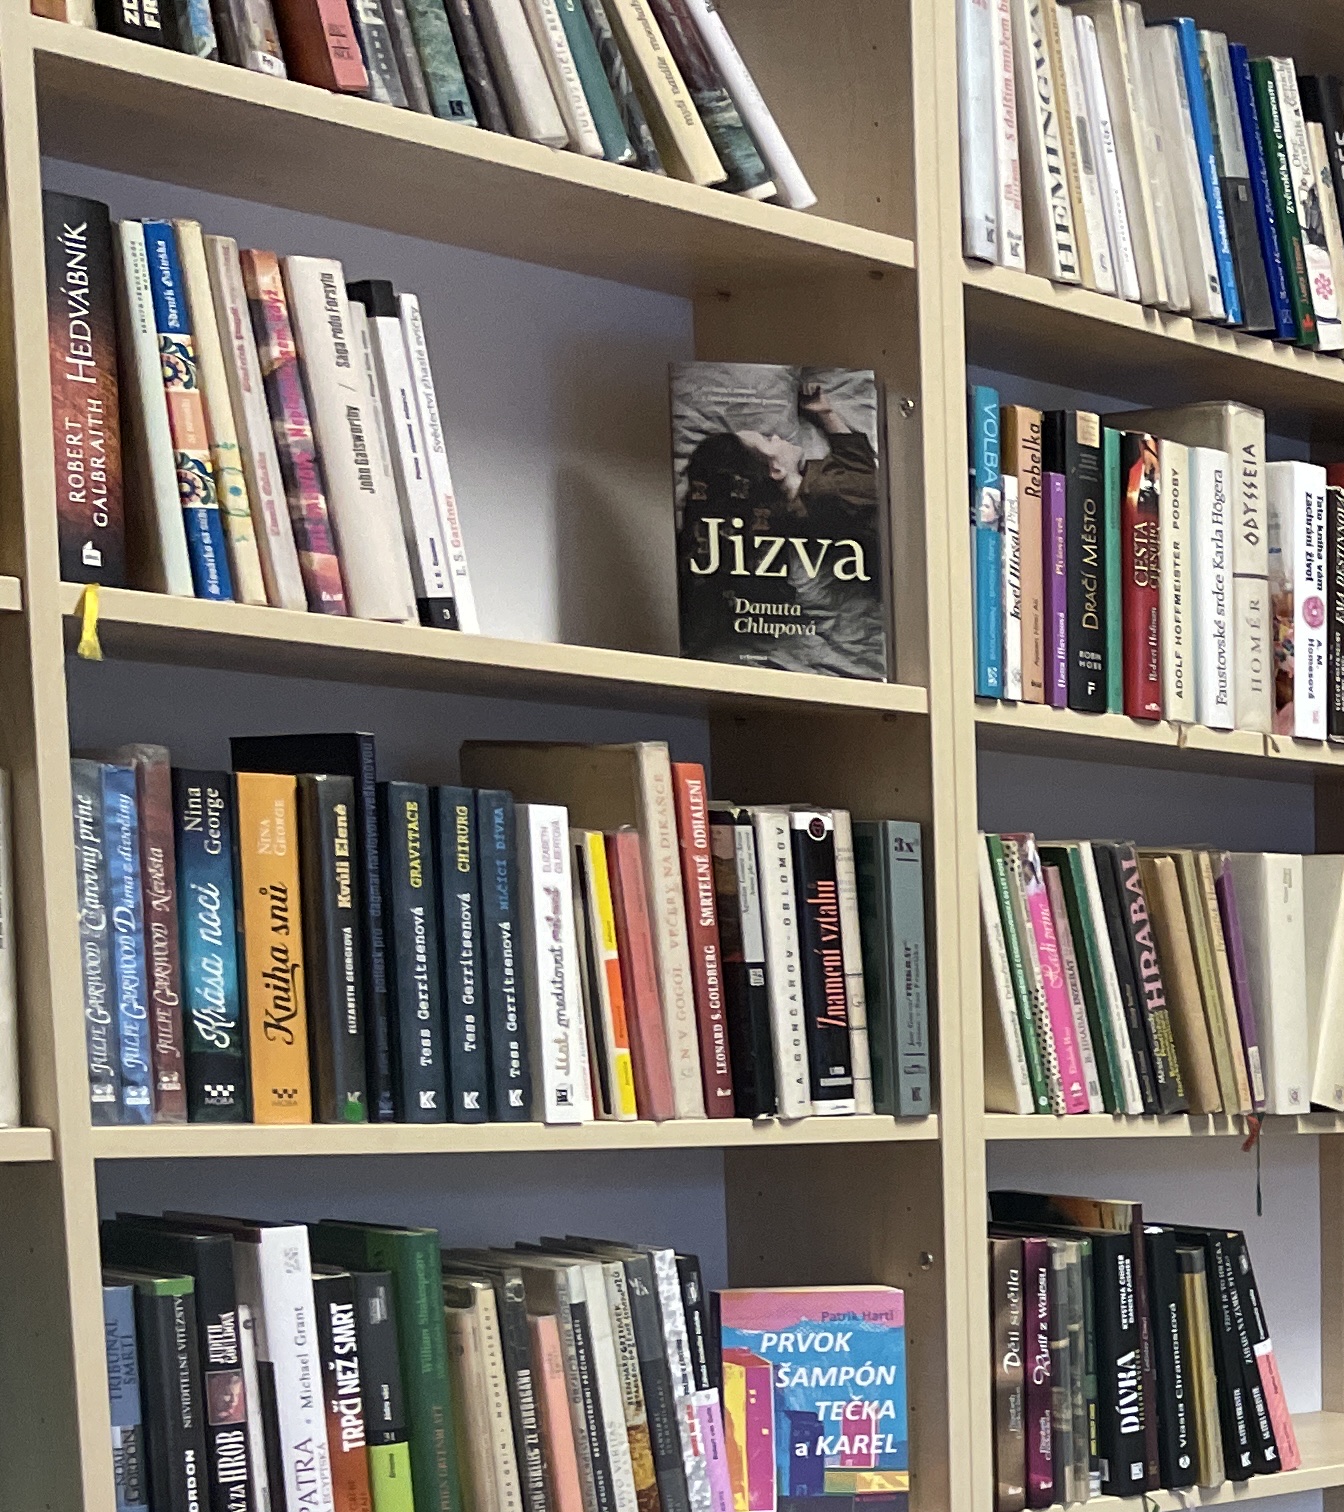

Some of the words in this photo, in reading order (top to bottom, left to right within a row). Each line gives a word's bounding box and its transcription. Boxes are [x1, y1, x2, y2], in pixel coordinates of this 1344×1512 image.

[64, 222, 96, 386] HEDVÁBNÍK
[67, 419, 86, 504] ROBERT
[90, 398, 109, 527] GALBRAITH
[983, 404, 1001, 496] VOLBA
[1024, 421, 1043, 498] Rebelka
[1173, 469, 1181, 530] PODOBY
[1212, 469, 1224, 527] Högera
[690, 517, 870, 581] Jizva
[1081, 498, 1098, 568] MĚSTO
[1214, 532, 1225, 569] Karla
[735, 598, 802, 616] Danuta
[1081, 574, 1100, 631] DRAČÍ
[1174, 540, 1184, 647] HOFFMEISTER
[1215, 574, 1226, 606] srdce
[733, 616, 817, 638] Chlupová
[1174, 653, 1184, 699] ADOLF
[1215, 610, 1228, 706] Faustovské
[184, 787, 201, 832] Nina
[205, 787, 223, 855] George
[408, 801, 423, 889] GRAVITACE
[201, 882, 220, 947] noci
[260, 882, 289, 936] snů
[410, 907, 430, 1020] Gerritsenová
[193, 953, 230, 1048] Krása
[262, 943, 299, 1045] Kniha
[419, 1029, 432, 1067] Tess
[294, 1307, 308, 1348] Grant
[330, 1303, 357, 1358] SMRT
[761, 1332, 852, 1353] PRVOK
[1168, 1303, 1182, 1398] Chramostová
[301, 1355, 316, 1409] Michael
[329, 1358, 359, 1397] NEŽ
[776, 1362, 895, 1388] ŠAMPÓN
[1118, 1350, 1138, 1433] DÍVKA
[333, 1400, 365, 1452] TRPČÍ
[816, 1395, 896, 1420] TEČKA
[1178, 1404, 1187, 1449] Vlasta
[795, 1442, 808, 1457] a
[815, 1435, 897, 1456] KAREL
